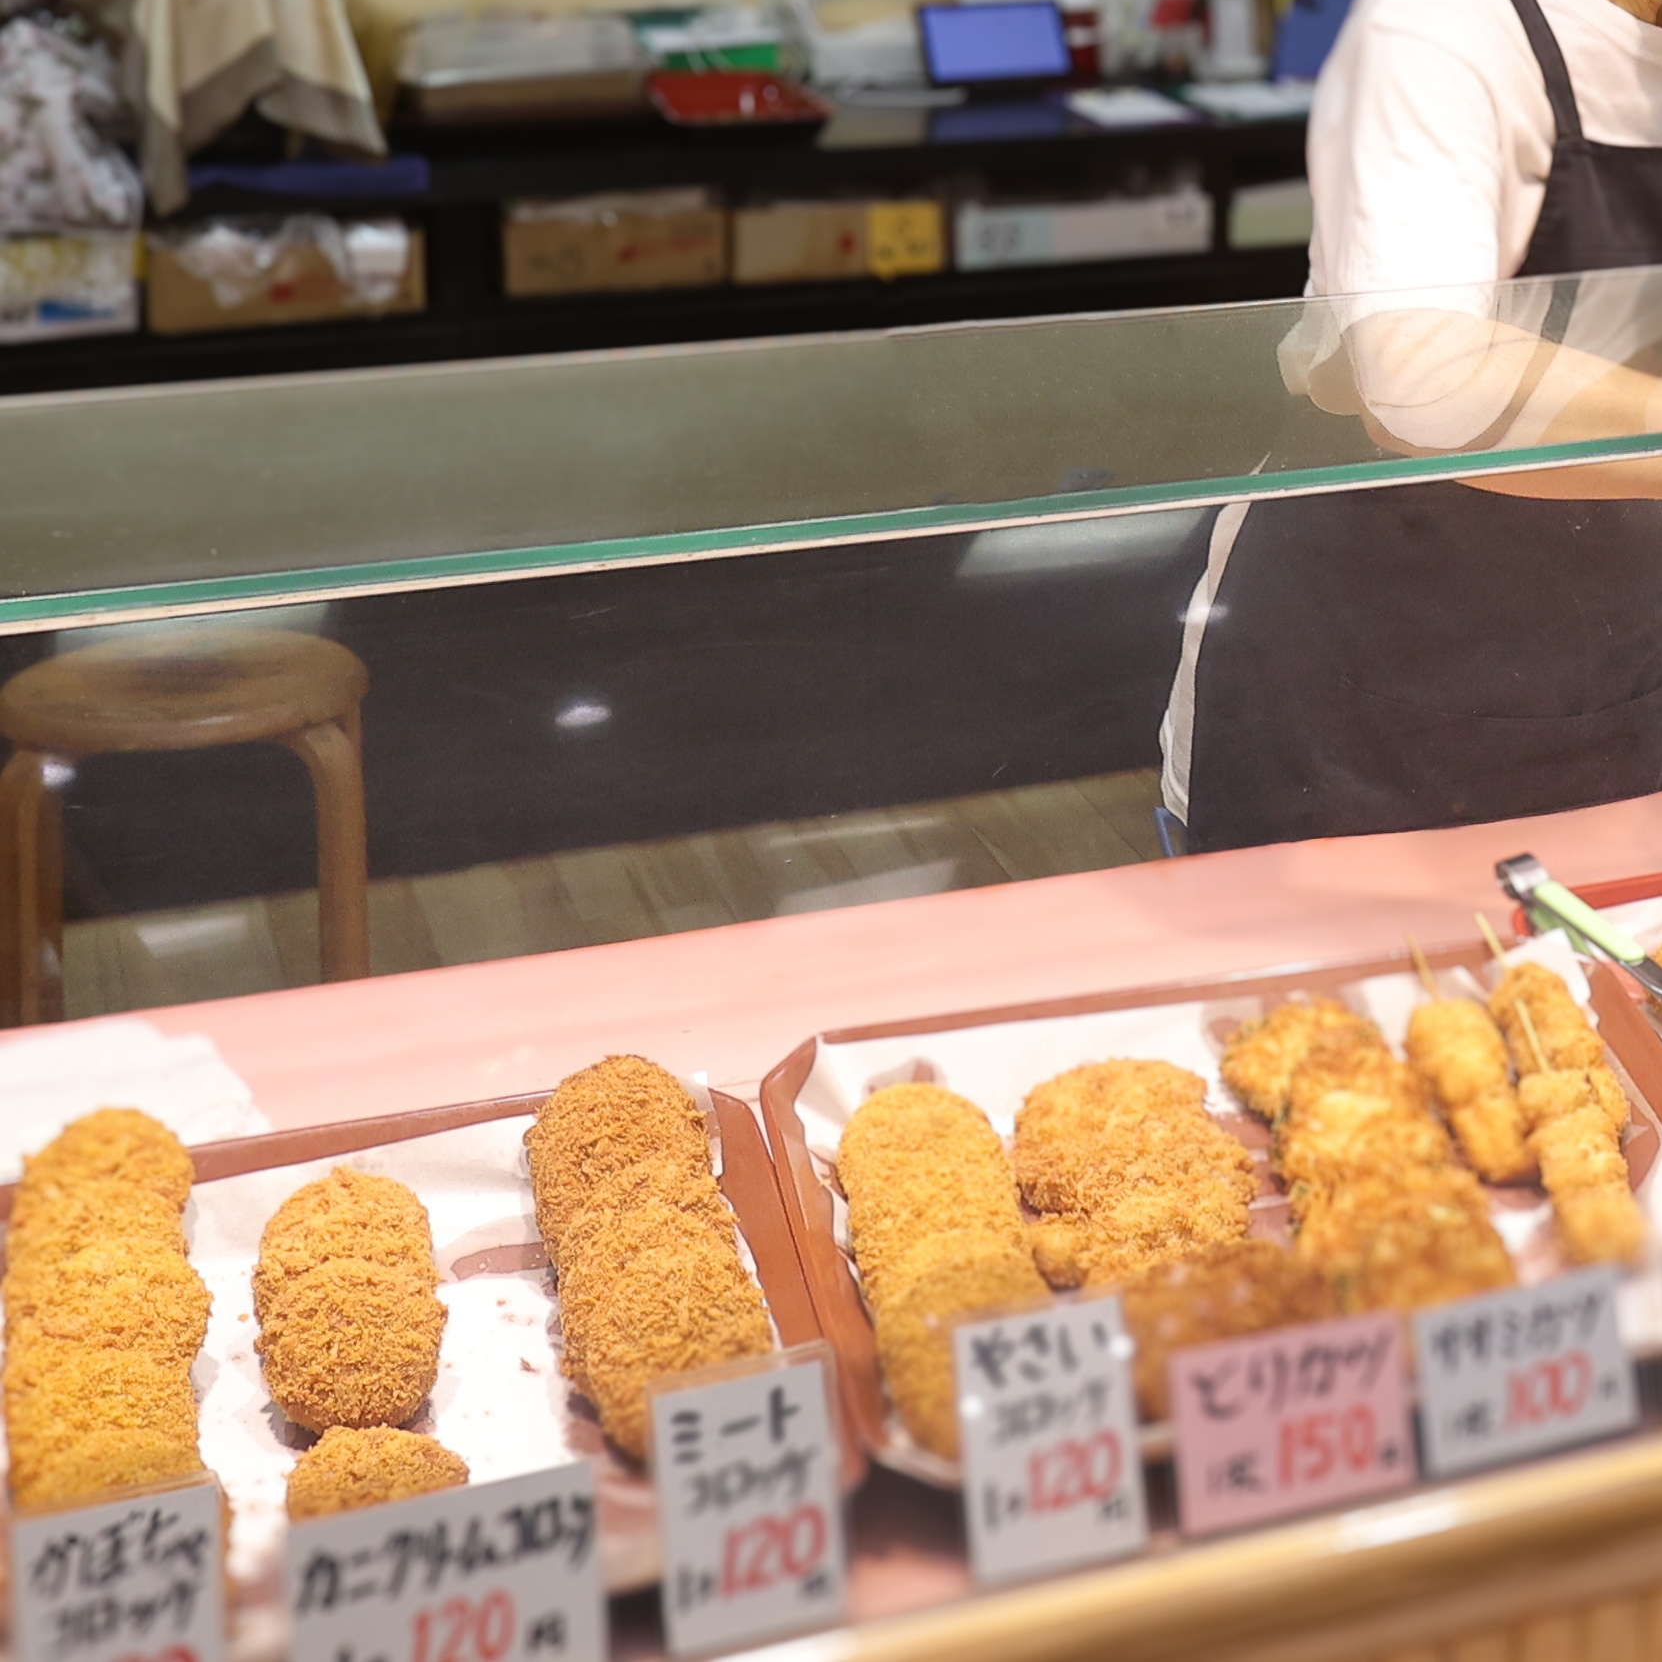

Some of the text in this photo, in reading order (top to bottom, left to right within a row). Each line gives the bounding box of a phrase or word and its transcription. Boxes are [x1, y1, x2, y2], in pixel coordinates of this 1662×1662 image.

[970, 1320, 1110, 1390] やさい
[669, 1385, 800, 1464] ミート
